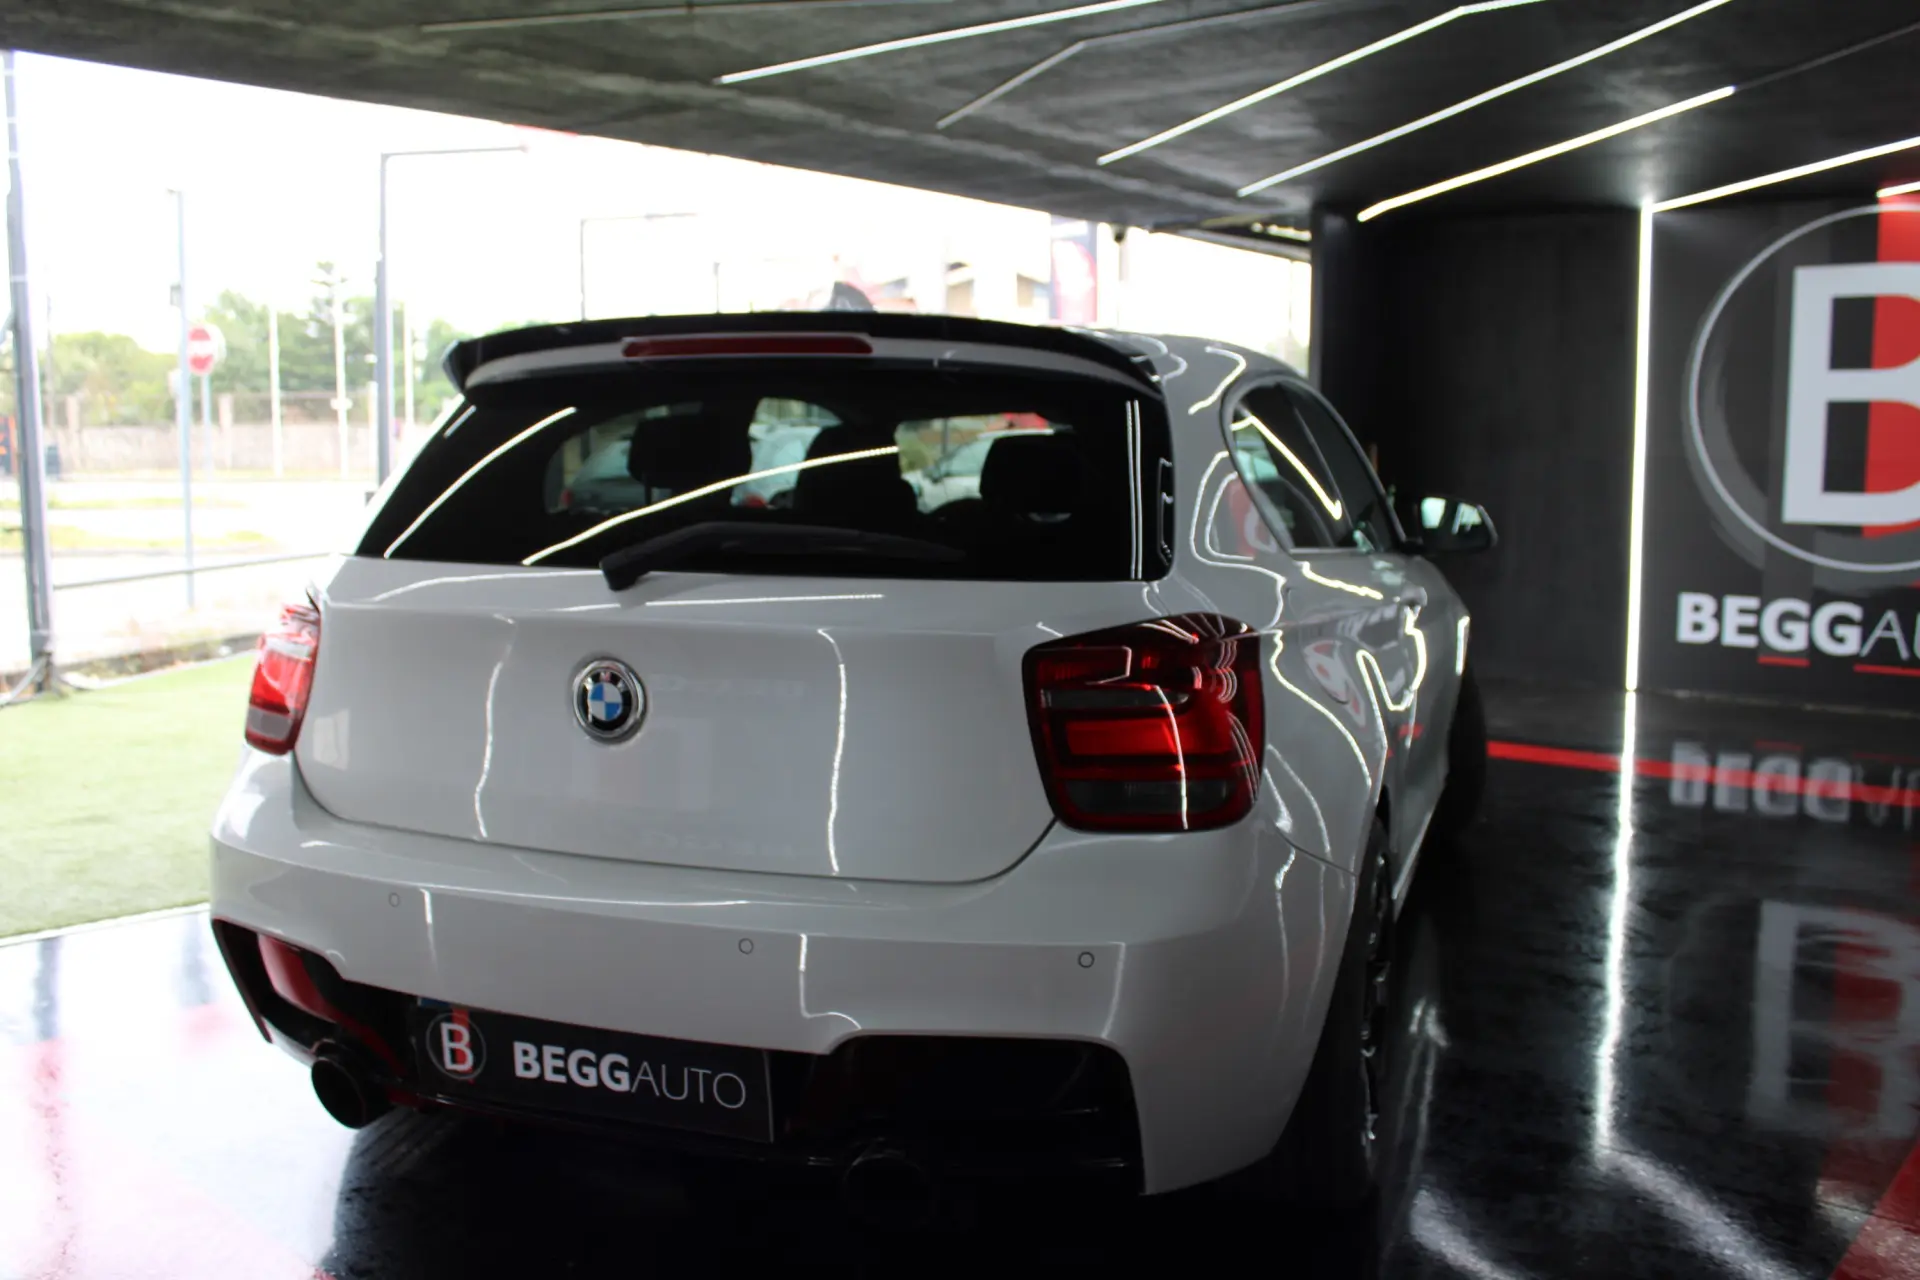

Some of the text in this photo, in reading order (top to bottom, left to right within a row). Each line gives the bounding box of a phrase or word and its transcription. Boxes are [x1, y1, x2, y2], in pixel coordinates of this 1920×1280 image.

[1782, 262, 1920, 526] B
[1676, 592, 1920, 661] BEGGA
[440, 1022, 474, 1071] B
[513, 1041, 746, 1109] BEGGAUTO
